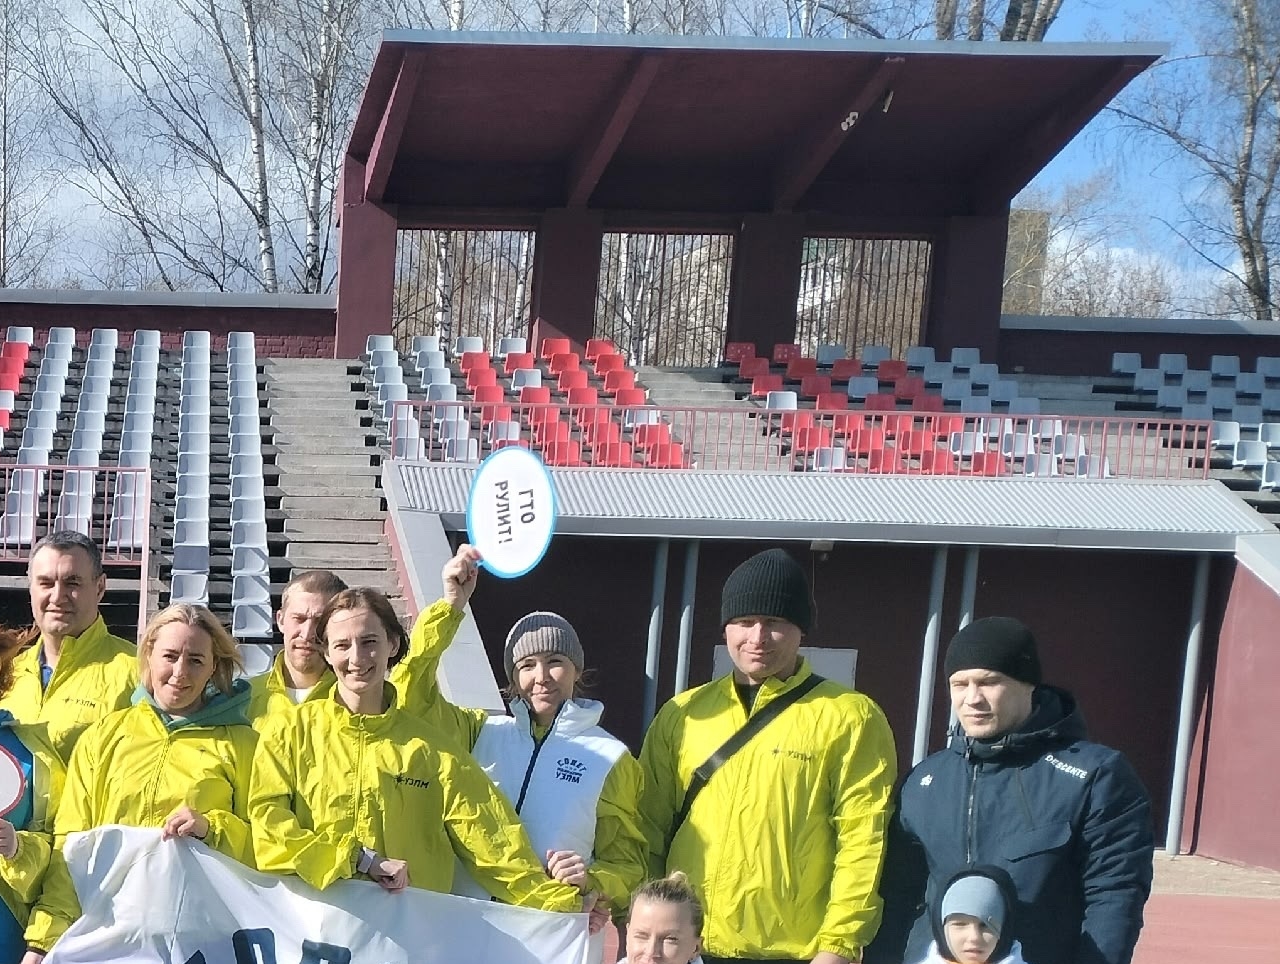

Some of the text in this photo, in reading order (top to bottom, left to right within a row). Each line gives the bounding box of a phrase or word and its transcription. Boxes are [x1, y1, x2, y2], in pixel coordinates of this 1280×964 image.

[494, 479, 513, 545] РУЛИТ!
[518, 488, 536, 524] ГТО
[555, 771, 581, 784] УЗПМ
[1044, 754, 1088, 779] DESCENTE
[404, 777, 430, 789] УЗПМ
